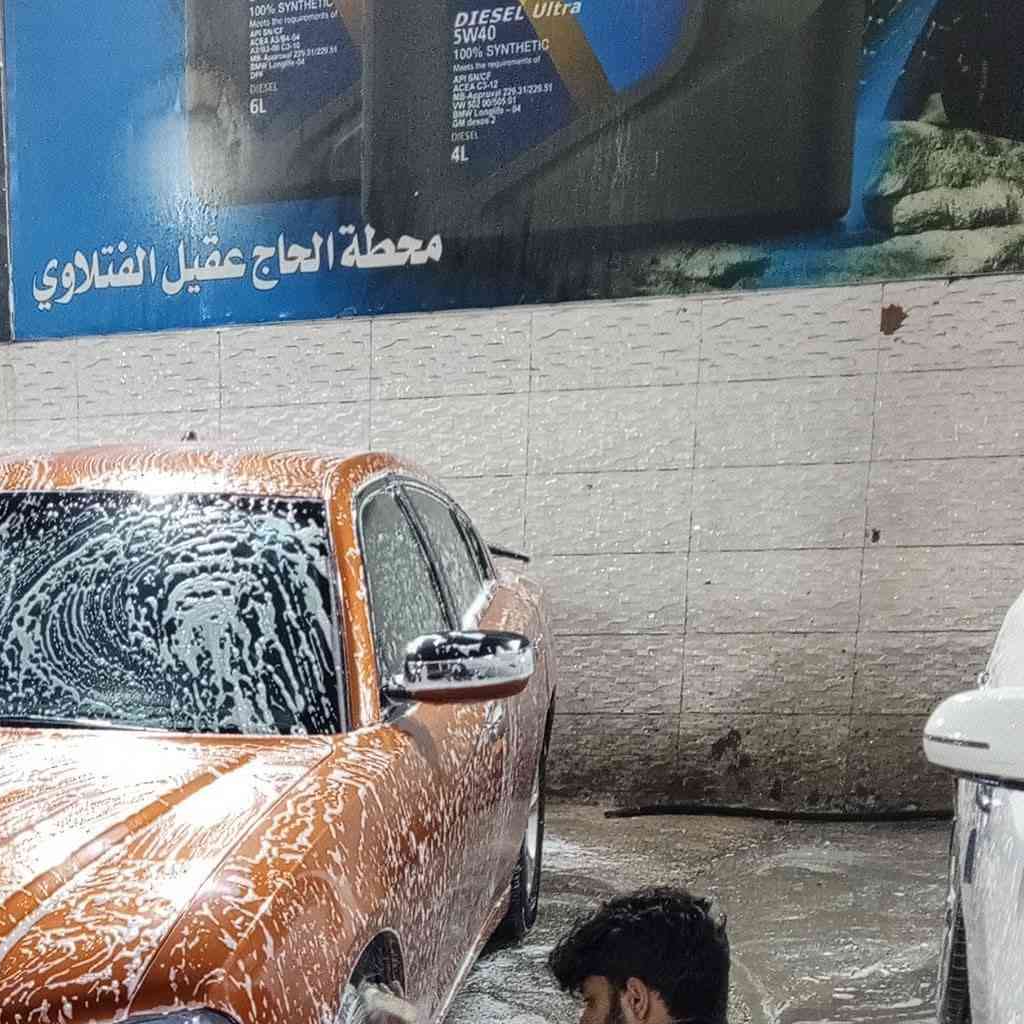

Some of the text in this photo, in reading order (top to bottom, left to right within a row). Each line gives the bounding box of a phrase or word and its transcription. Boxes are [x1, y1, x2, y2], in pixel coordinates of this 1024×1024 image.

[249, 4, 276, 17] 100%
[455, 0, 582, 28] DIESEL Ultra
[453, 25, 496, 45] 5W40
[454, 38, 550, 60] 100% SYNTHETIC
[249, 97, 267, 114] 6L
[451, 144, 470, 163] 4L
[32, 223, 443, 310] محطة الحاج عقيل الفتلاوي
